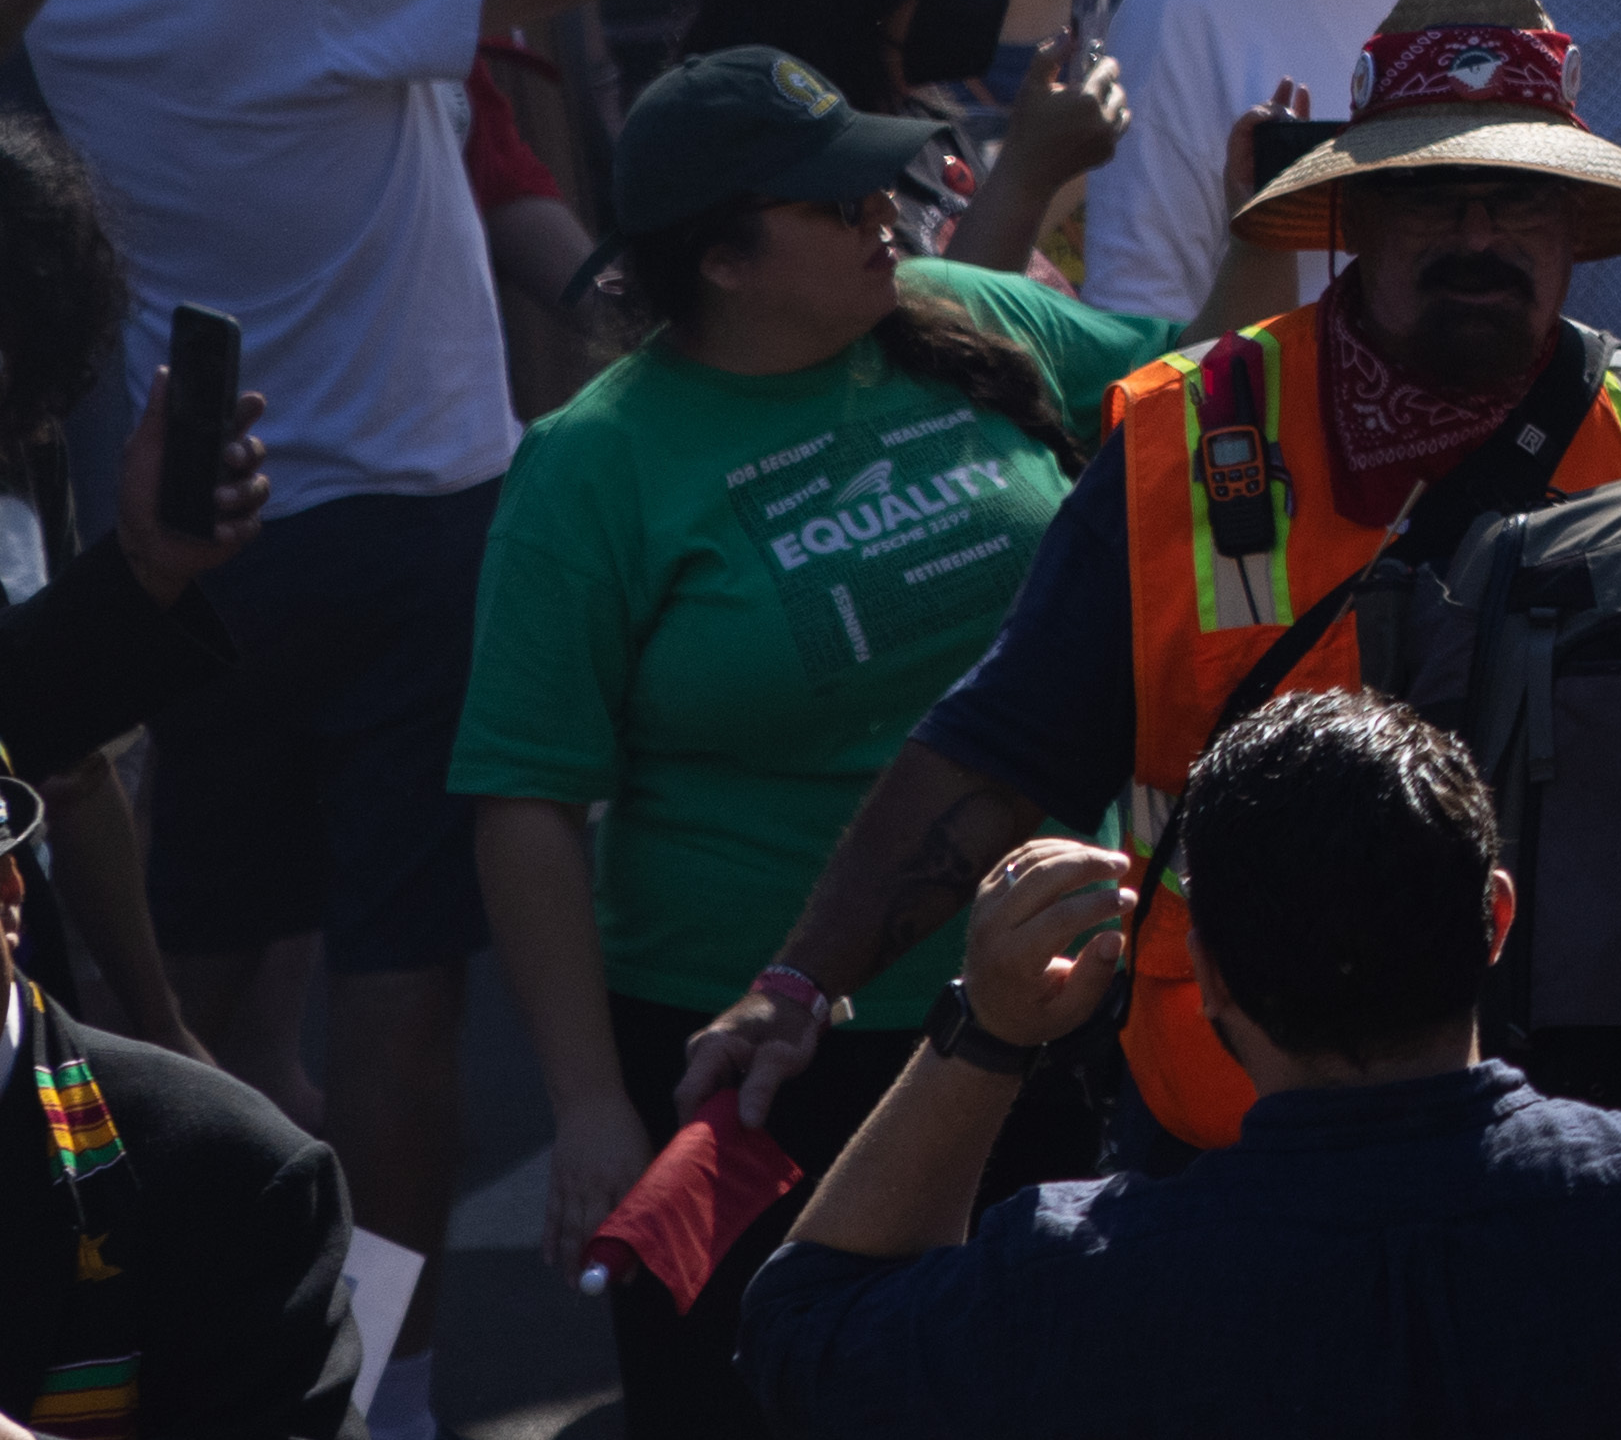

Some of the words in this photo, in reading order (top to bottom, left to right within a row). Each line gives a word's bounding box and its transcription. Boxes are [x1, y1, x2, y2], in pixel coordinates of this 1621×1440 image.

[726, 464, 757, 489] JOB
[760, 432, 834, 473] SECURITY
[764, 475, 832, 520] JUSTICE
[771, 459, 1008, 571] EQUALITY
[861, 525, 927, 560] AFSCME
[904, 533, 1011, 585] RETIREMENT
[830, 582, 870, 664] FAIRNESS
